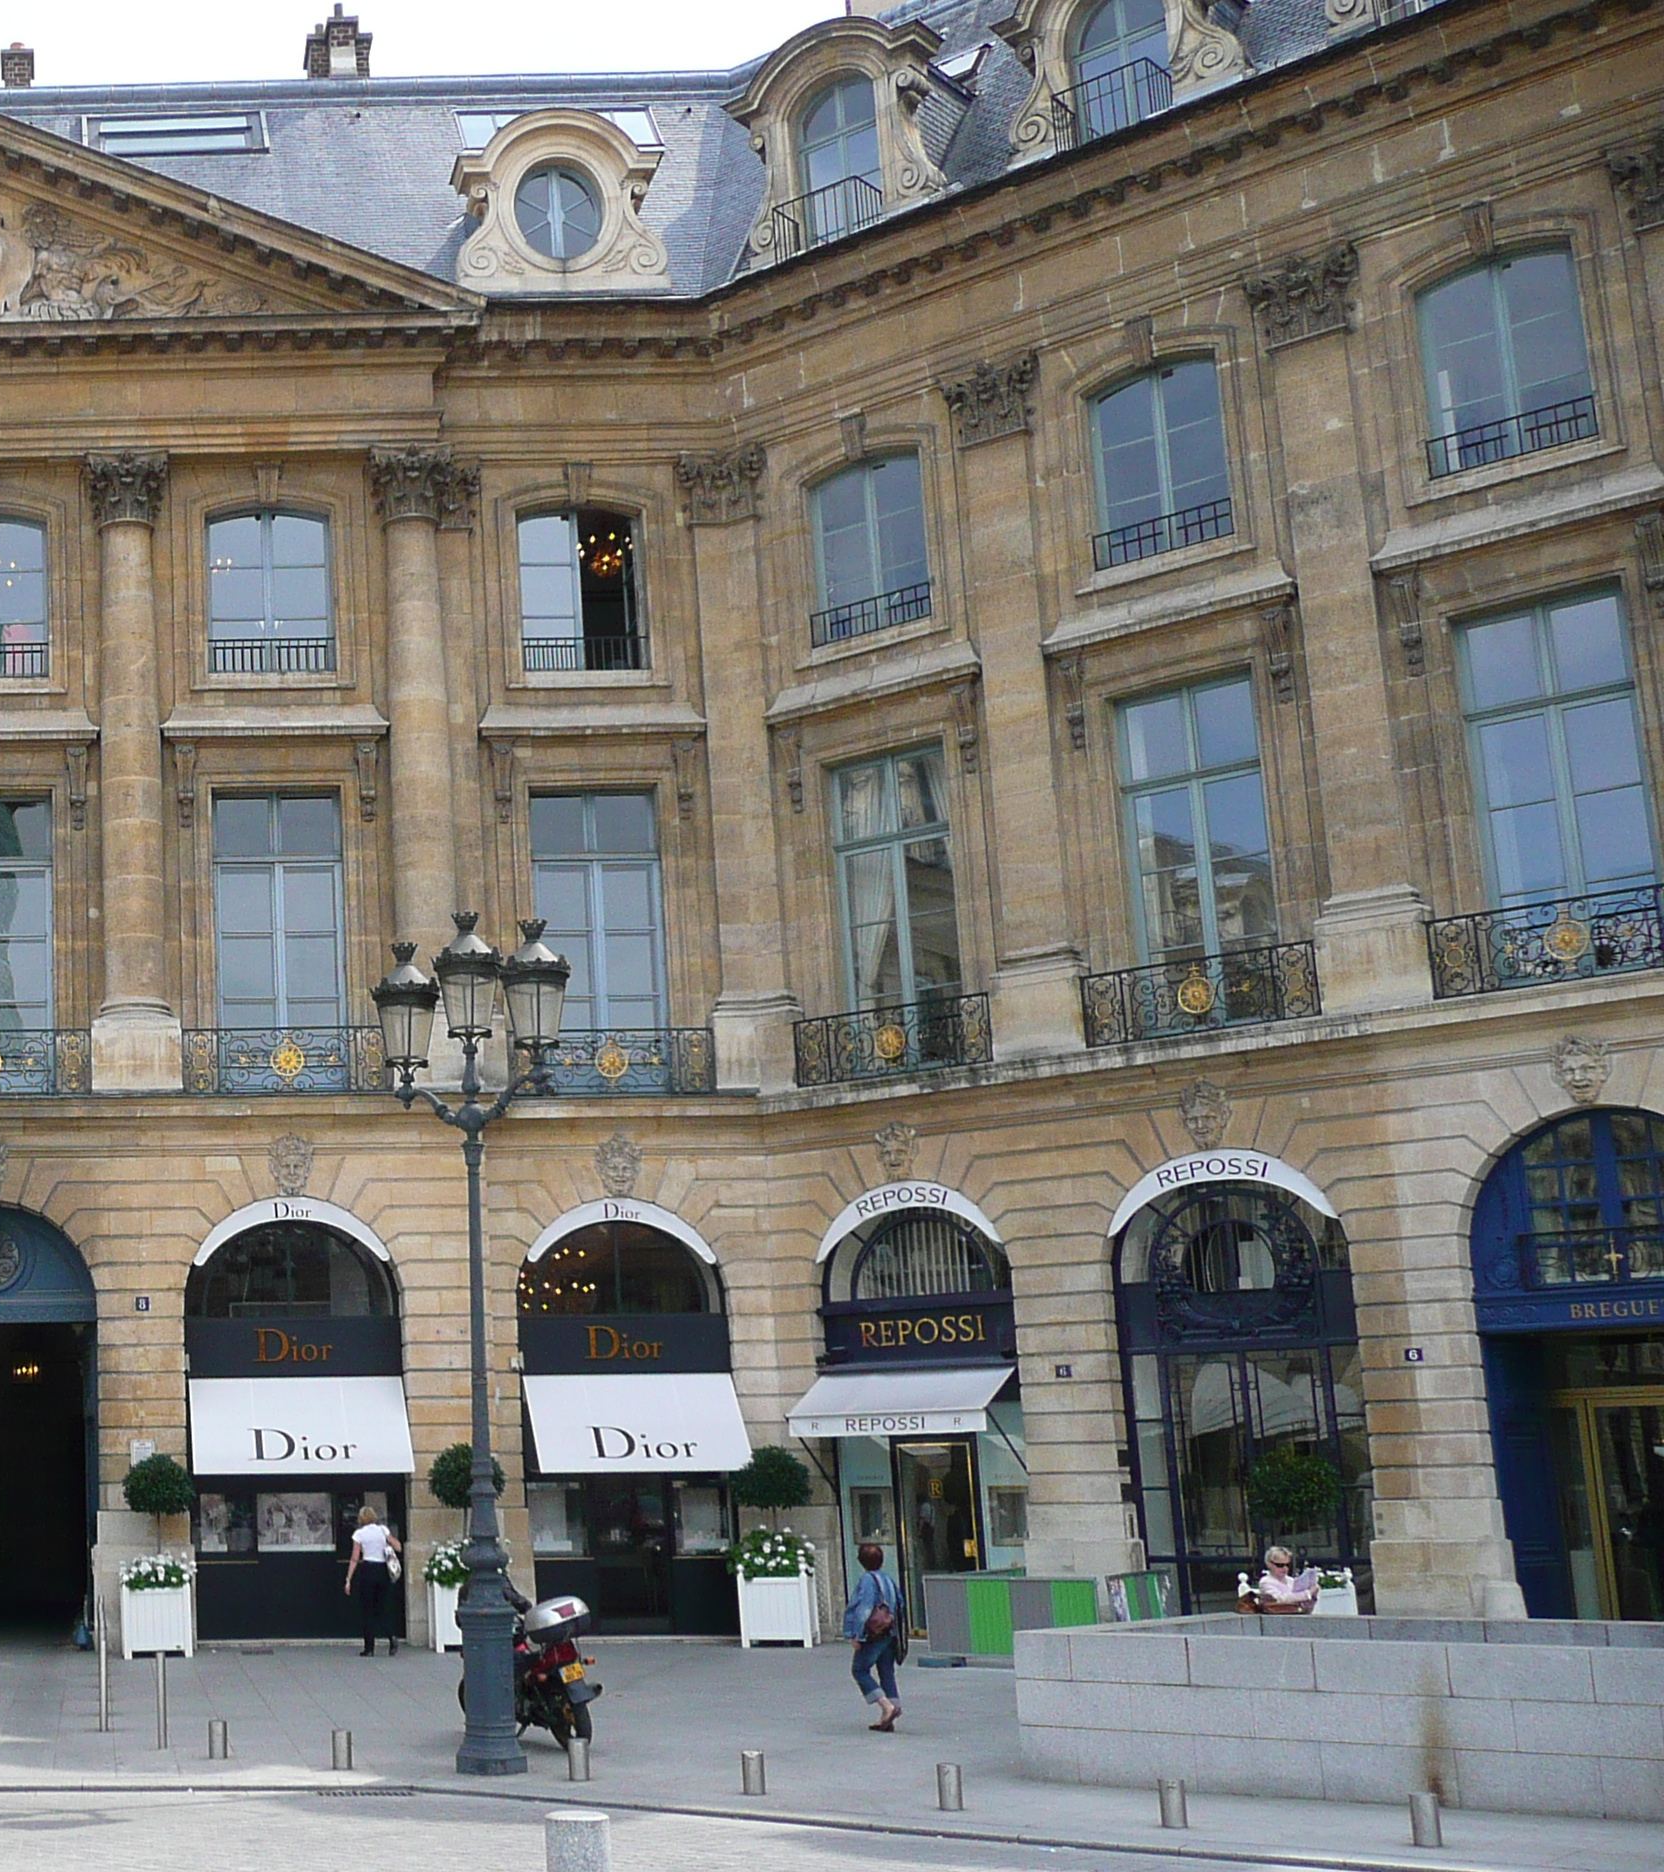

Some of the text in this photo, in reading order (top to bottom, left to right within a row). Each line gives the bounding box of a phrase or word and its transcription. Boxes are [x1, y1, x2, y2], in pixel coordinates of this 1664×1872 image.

[1156, 1158, 1268, 1188] REPOSSI
[273, 1202, 312, 1219] Dior
[604, 1202, 641, 1220] Dior
[855, 1187, 948, 1218] REPOSSI
[139, 1299, 146, 1309] 8
[253, 1328, 333, 1362] Dior
[584, 1325, 664, 1359] Dior
[859, 1315, 987, 1347] REPOSSI
[1409, 1349, 1418, 1360] 6
[811, 1416, 962, 1432] R REPOSSI R
[247, 1428, 357, 1461] Dior
[586, 1426, 698, 1459] Dior
[931, 1482, 941, 1495] R
